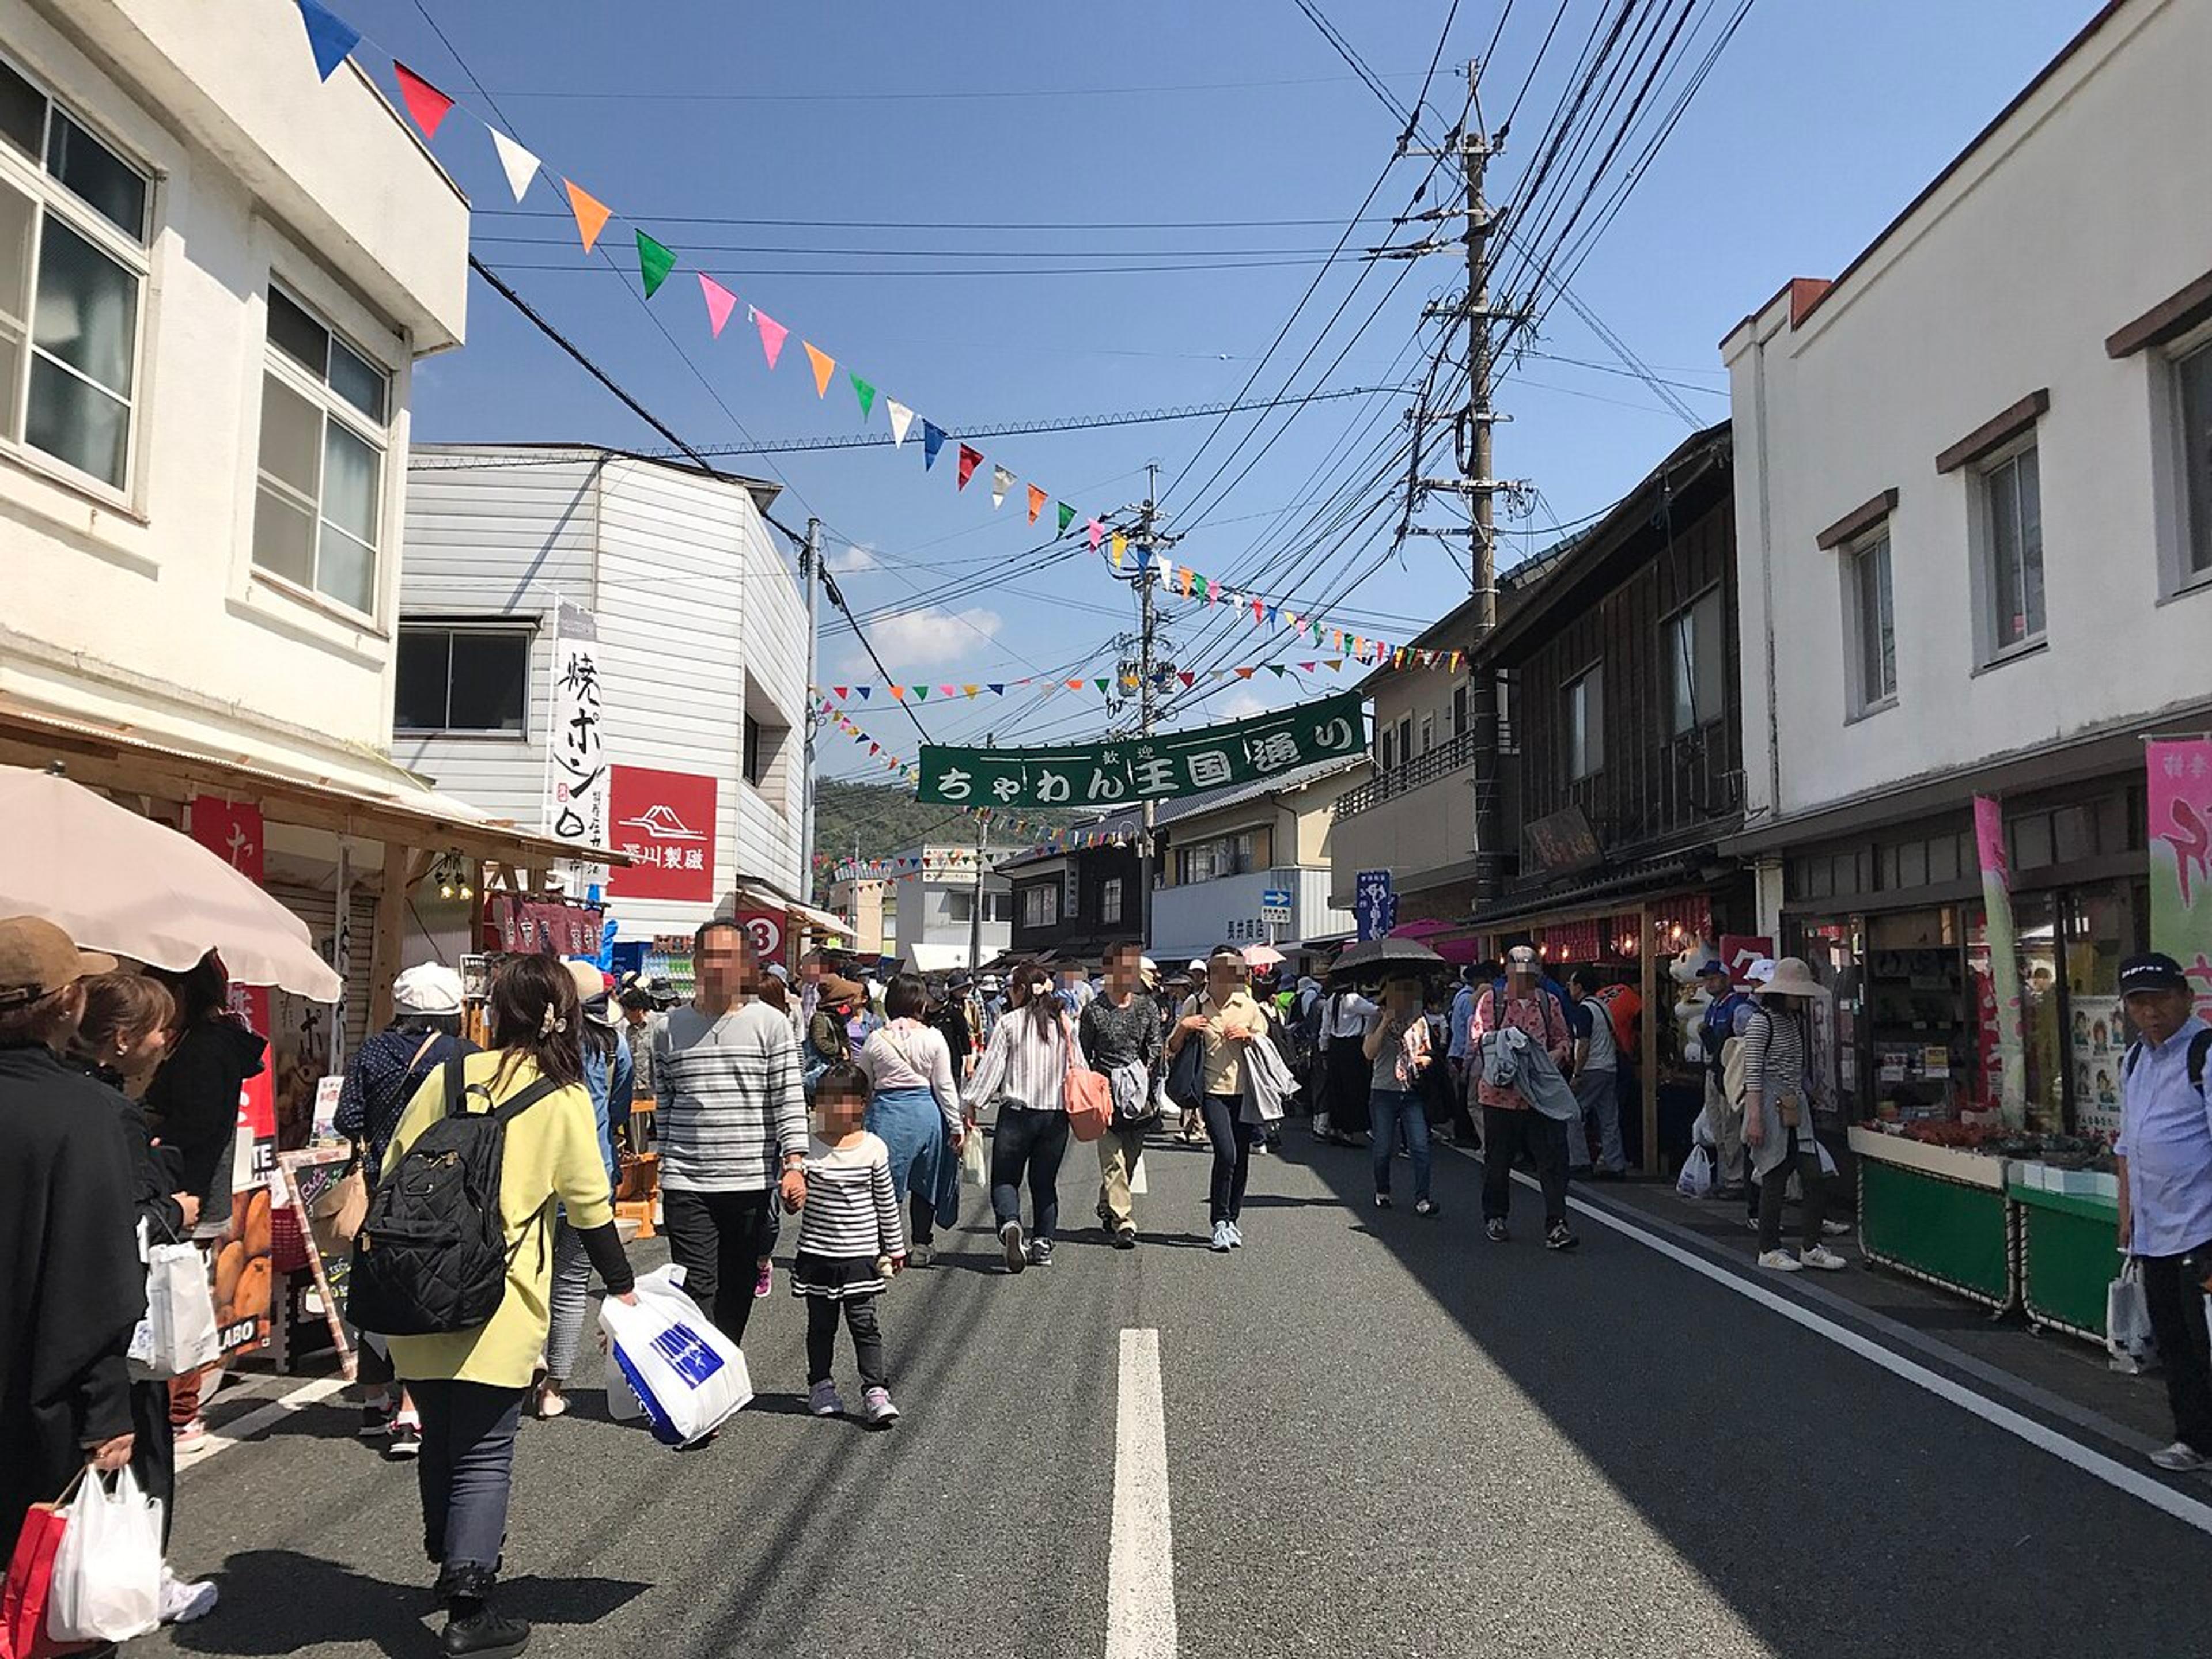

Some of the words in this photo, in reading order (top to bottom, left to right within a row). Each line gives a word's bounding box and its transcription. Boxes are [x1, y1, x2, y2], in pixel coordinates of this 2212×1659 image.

[938, 717, 1354, 802] ちゃわん王国通り
[1102, 744, 1156, 765] 歓迎
